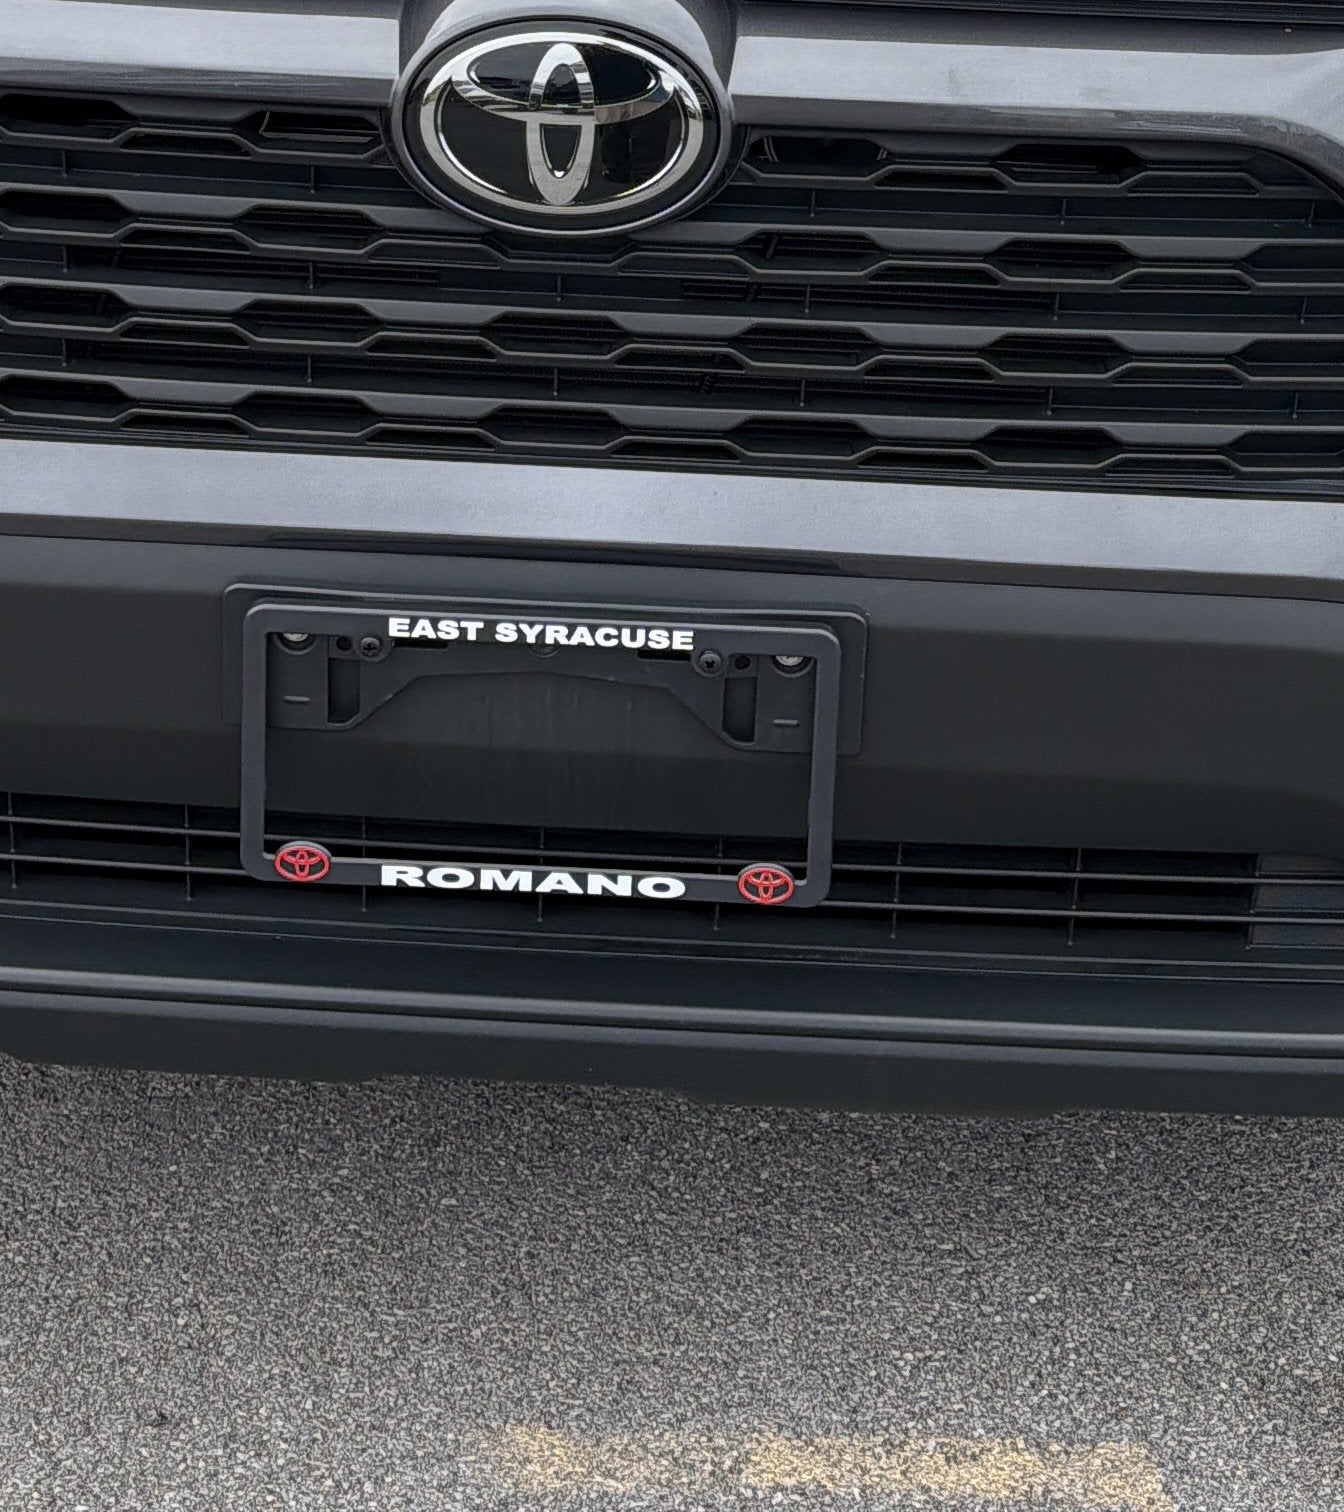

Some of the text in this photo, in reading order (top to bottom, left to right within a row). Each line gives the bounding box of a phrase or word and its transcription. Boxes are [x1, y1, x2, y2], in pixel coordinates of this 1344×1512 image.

[388, 617, 695, 651] EAST SYRACUSE
[380, 864, 686, 899] ROMANO
